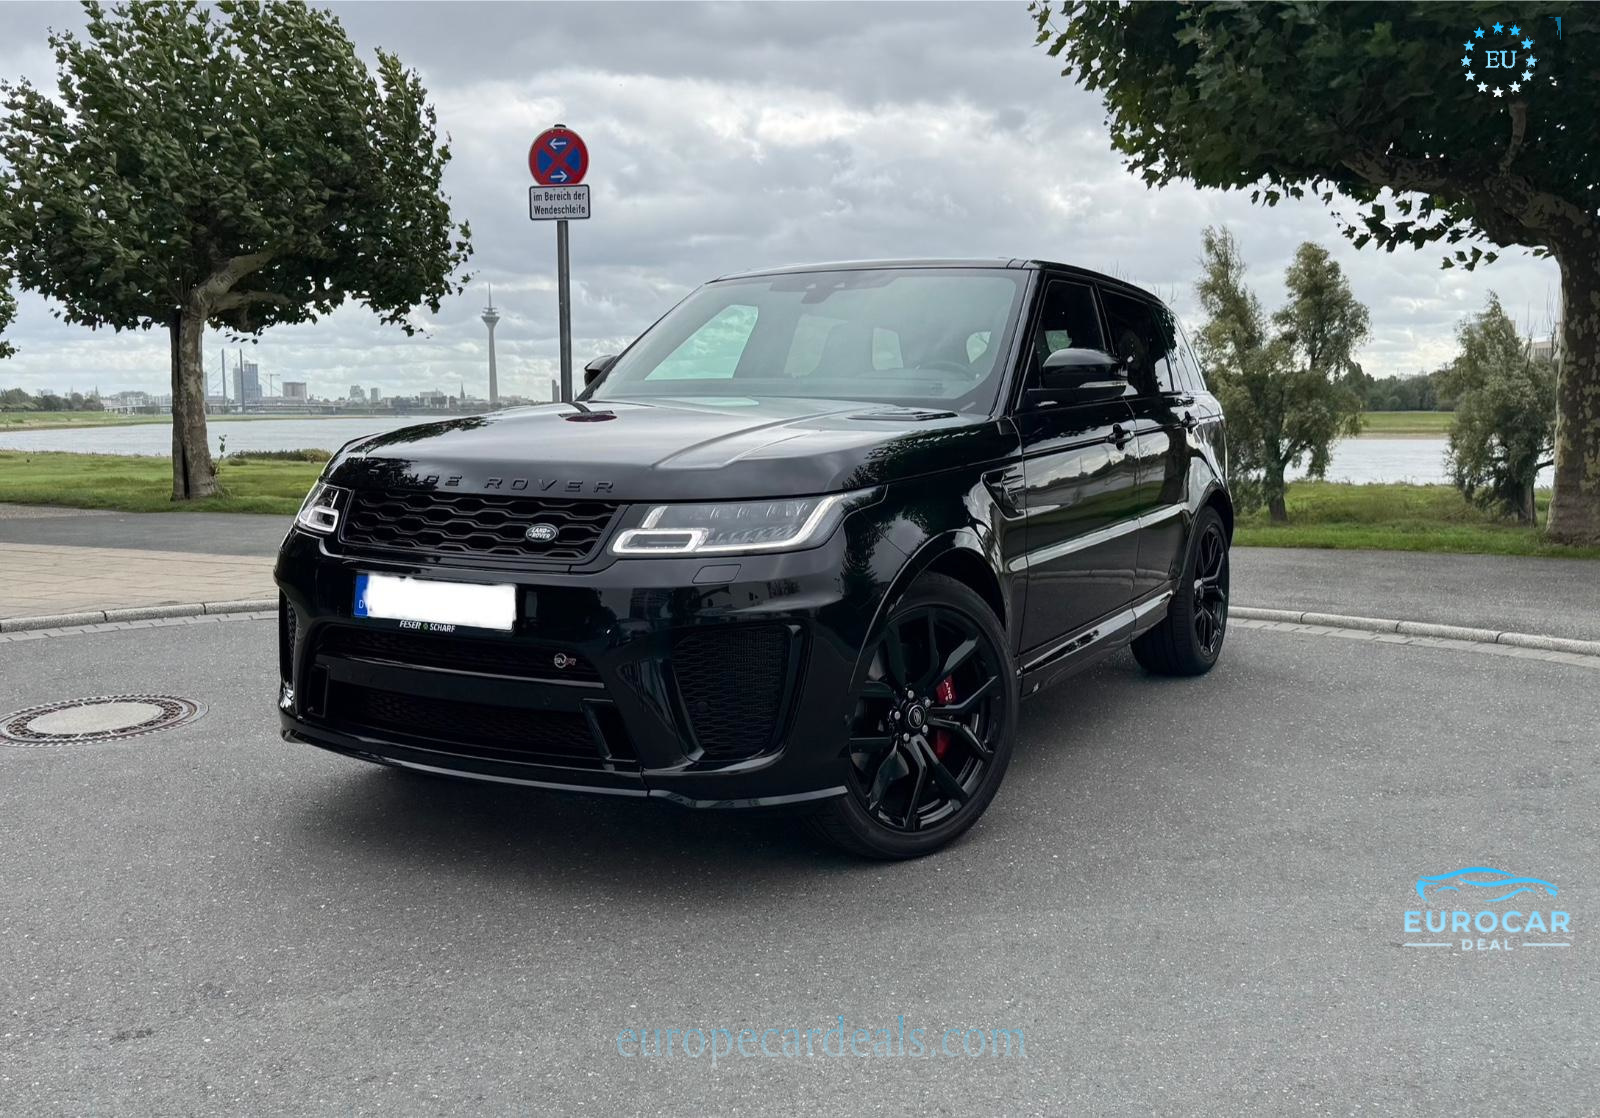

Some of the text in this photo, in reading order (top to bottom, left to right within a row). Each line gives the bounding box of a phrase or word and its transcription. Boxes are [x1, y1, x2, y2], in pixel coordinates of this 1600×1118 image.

[533, 190, 585, 202] im Bereich der
[533, 204, 586, 215] Wendeschleife
[484, 477, 615, 494] ROVER
[358, 599, 365, 609] D
[399, 619, 456, 633] FESER SCHARF
